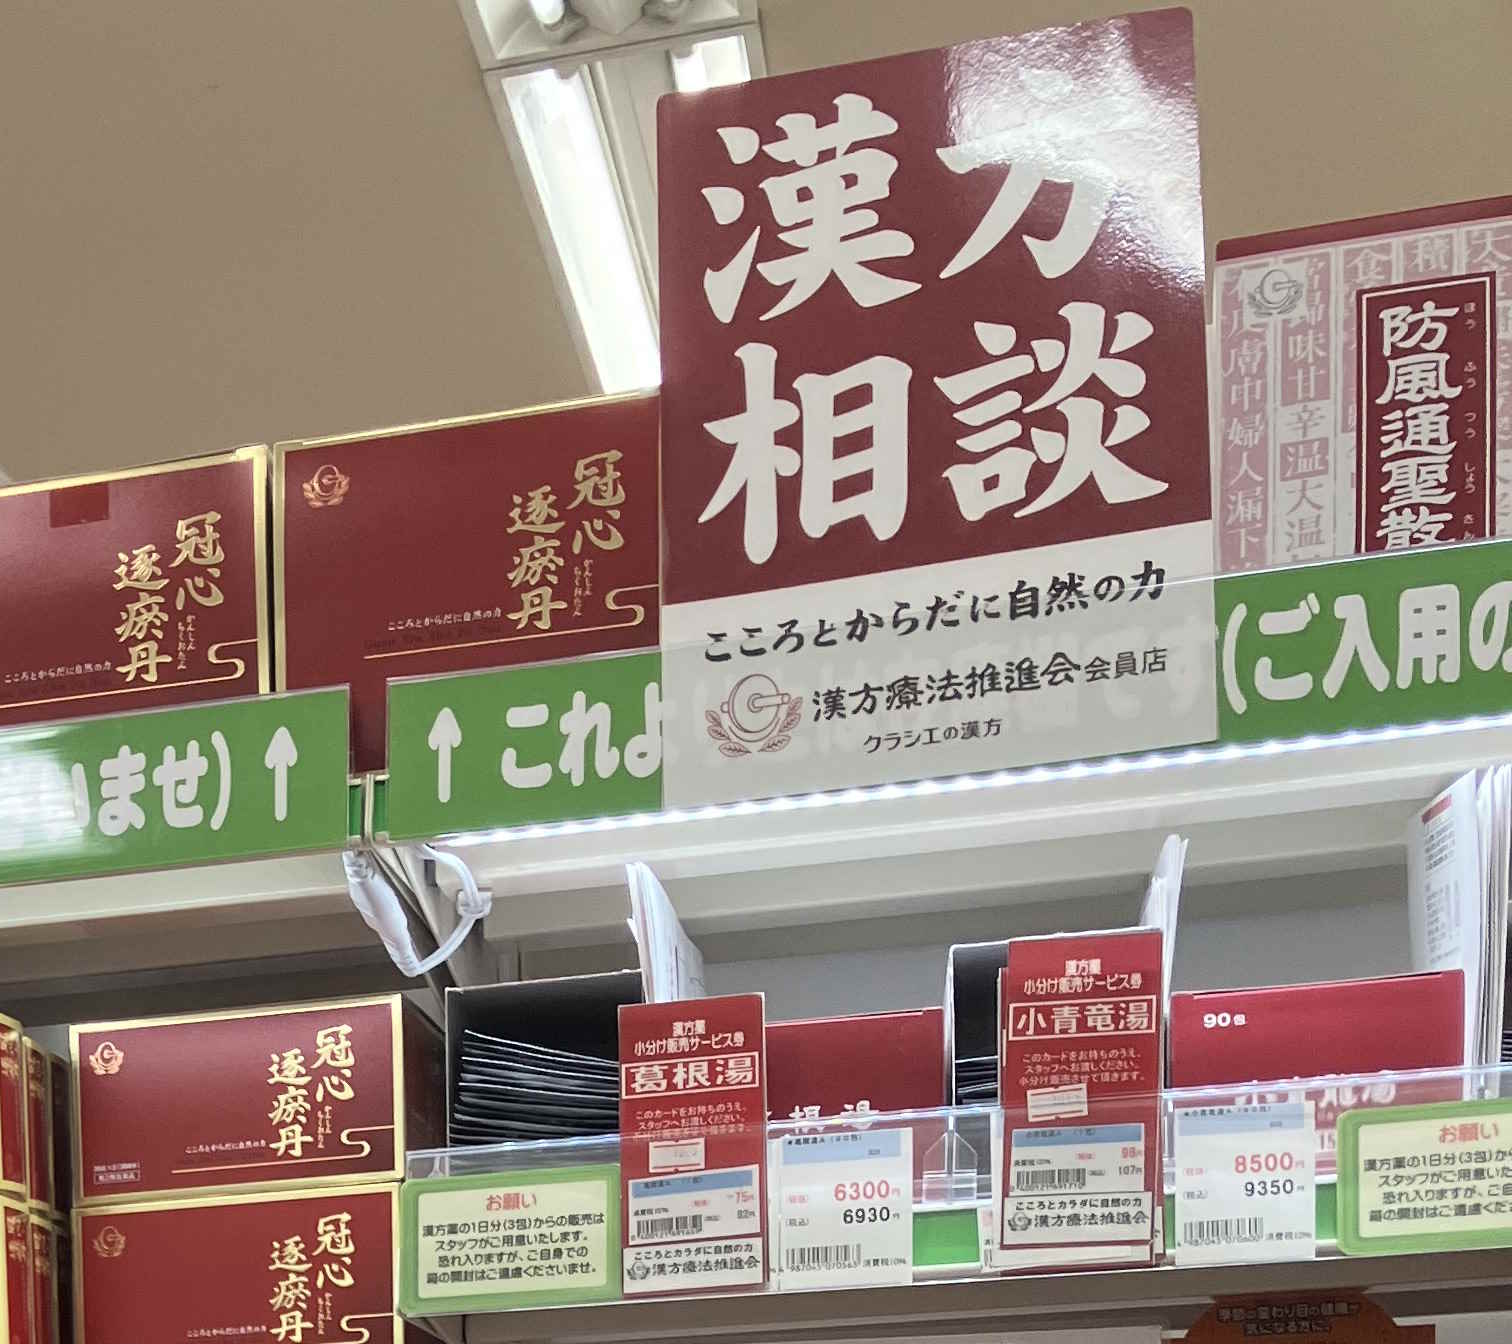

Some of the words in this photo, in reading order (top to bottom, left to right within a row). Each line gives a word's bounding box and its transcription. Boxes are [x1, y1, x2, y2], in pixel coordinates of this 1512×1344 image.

[700, 93, 1115, 325] 漢方
[697, 302, 1170, 564] 相談
[703, 561, 1165, 663] こころとからだに自然の力
[862, 719, 1002, 754] クラシエの漢方
[1016, 1003, 1150, 1034] 小青竜湯
[629, 1056, 754, 1093] 葛根湯
[486, 1193, 537, 1211] お願い
